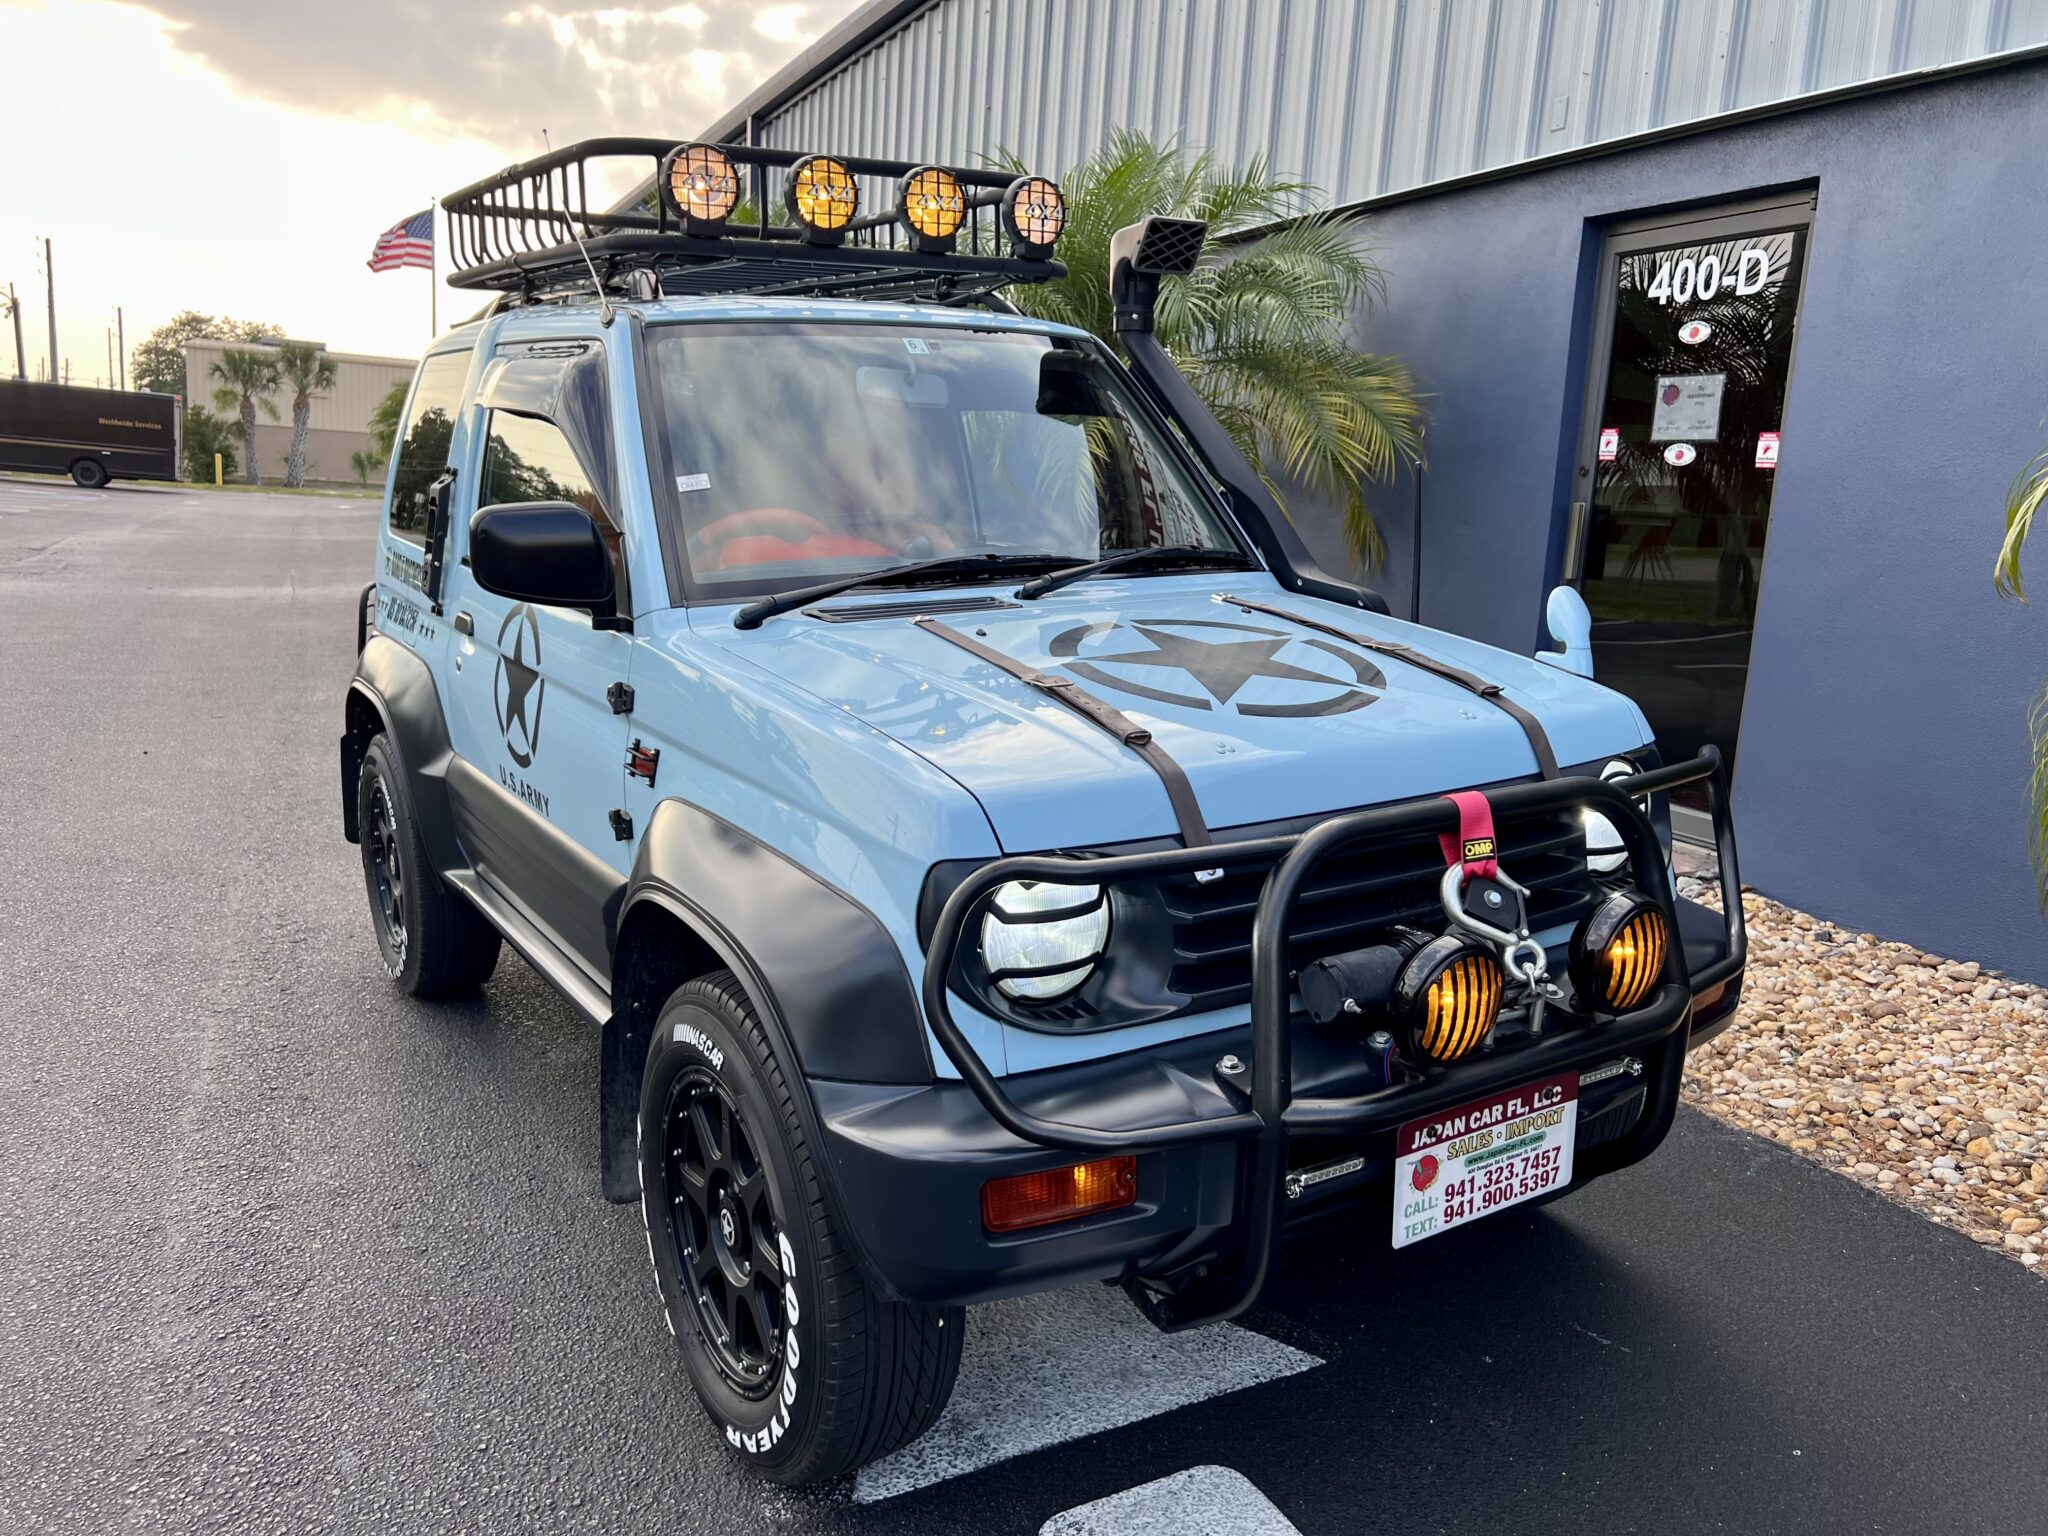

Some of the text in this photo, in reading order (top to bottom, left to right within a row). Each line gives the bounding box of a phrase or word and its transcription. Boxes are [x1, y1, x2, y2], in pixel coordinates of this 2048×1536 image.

[682, 171, 731, 192] 4X4
[807, 182, 851, 202] 4X4
[917, 194, 960, 212] 4X4
[1025, 203, 1063, 220] 4X4
[1648, 248, 1769, 304] 400-D
[98, 417, 162, 430] Worldwide Services
[1465, 842, 1494, 857] OMP
[689, 1025, 724, 1071] NASCAR
[1470, 1104, 1503, 1129] CAR
[1507, 1098, 1529, 1117] FL,
[1448, 1106, 1565, 1161] SALES IMPORT
[1467, 1134, 1544, 1165] www.JapanCar-FL.com
[1404, 1196, 1439, 1218] CALL:
[1445, 1145, 1562, 1203] 941.323.7457
[1405, 1216, 1438, 1239] TEXT:
[1444, 1165, 1561, 1224] 941.900.5397
